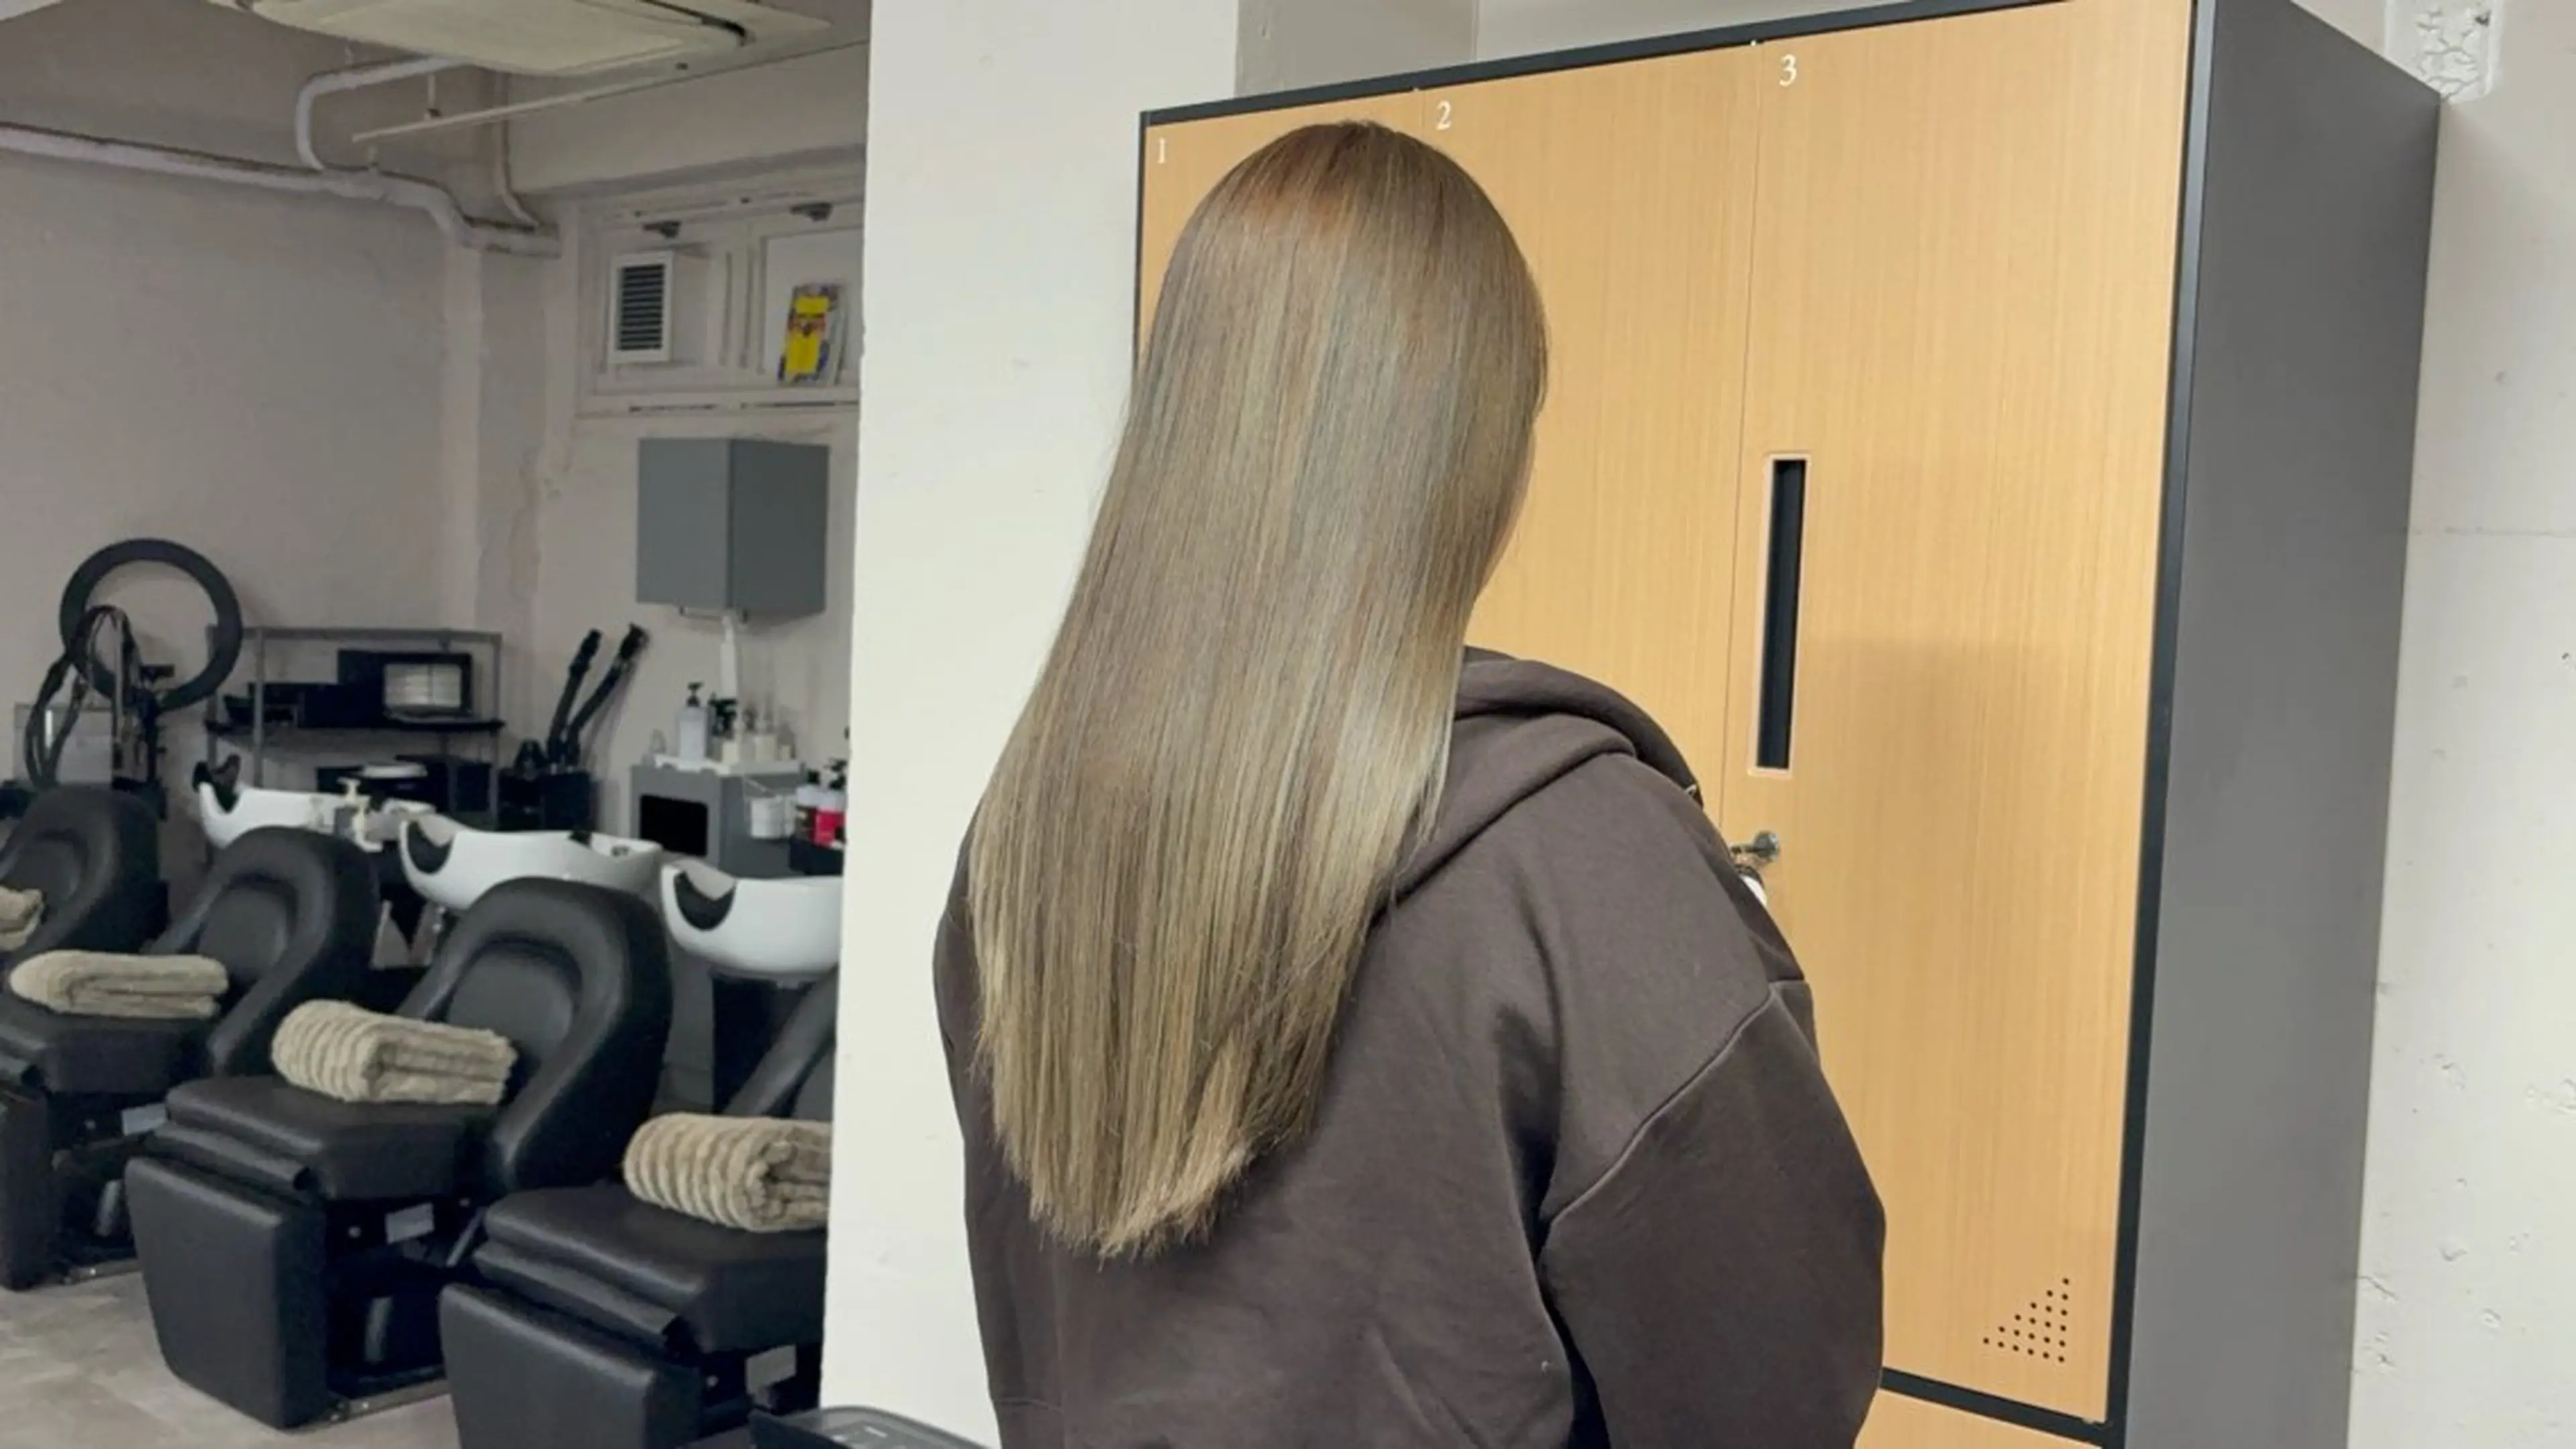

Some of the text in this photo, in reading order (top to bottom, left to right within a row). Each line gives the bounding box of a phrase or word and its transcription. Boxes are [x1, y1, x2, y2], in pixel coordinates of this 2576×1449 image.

[1779, 54, 1796, 87] 3
[1436, 101, 1452, 130] 2
[1157, 137, 1166, 164] 1
